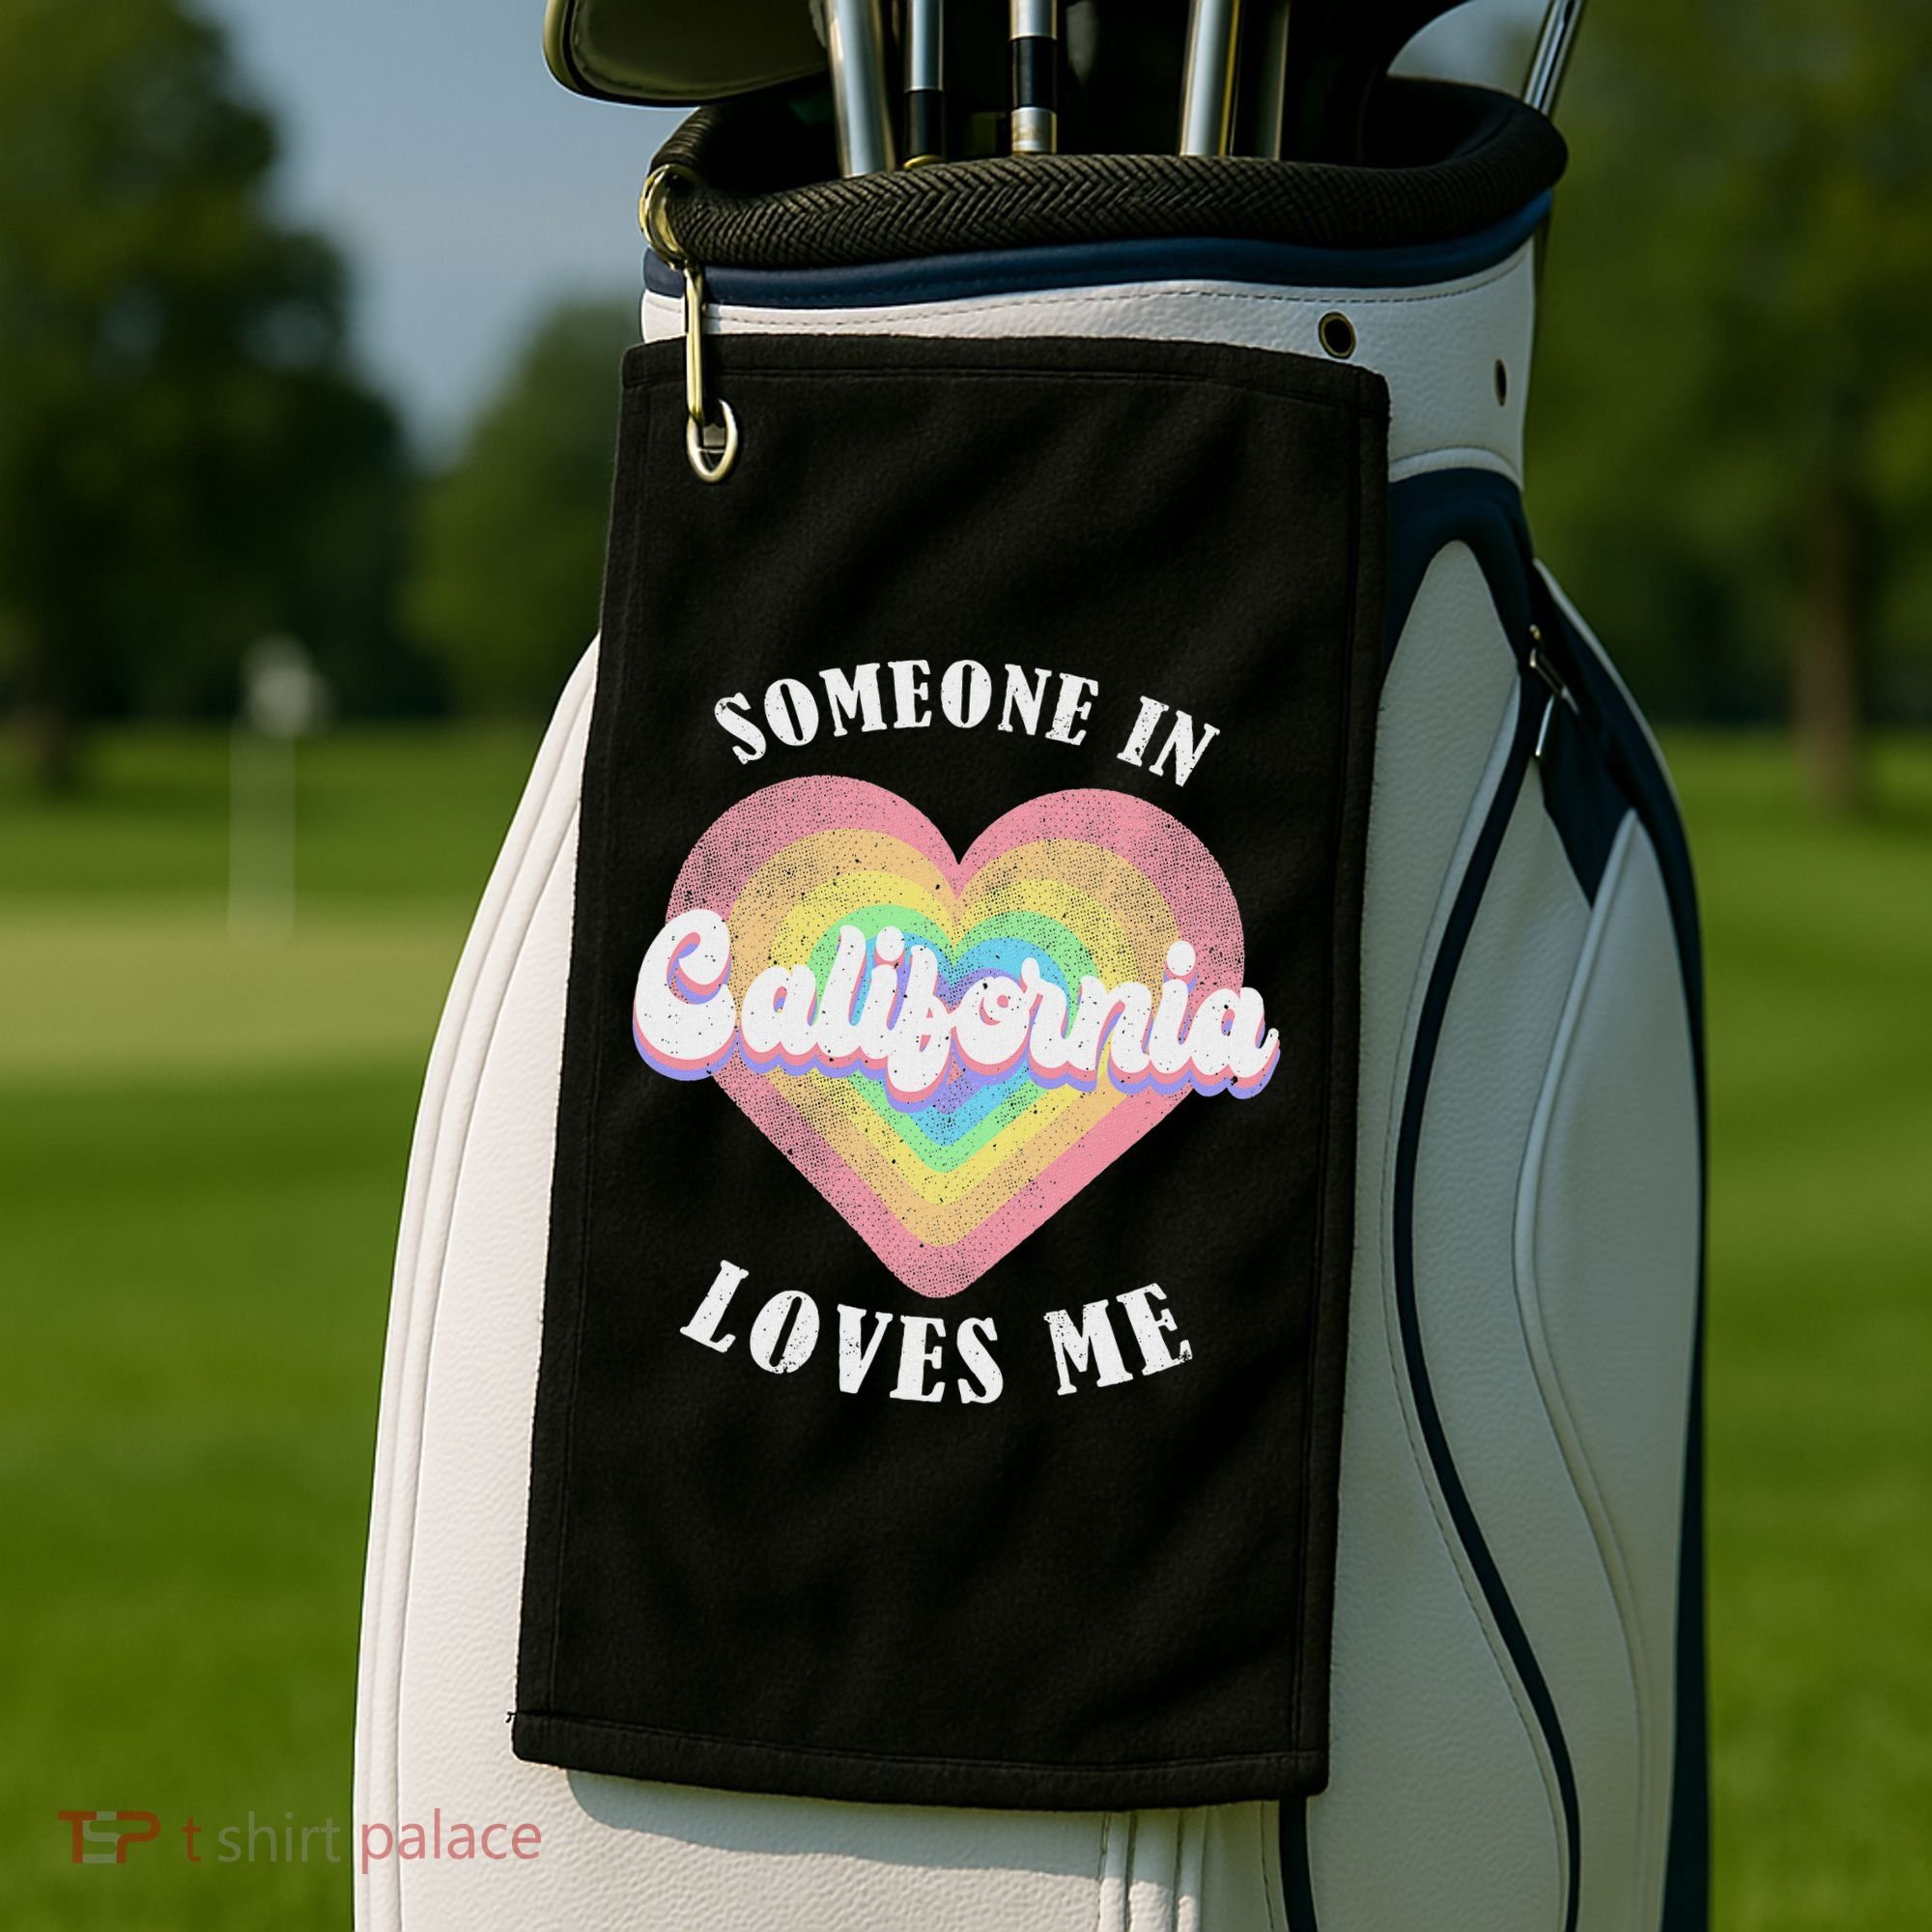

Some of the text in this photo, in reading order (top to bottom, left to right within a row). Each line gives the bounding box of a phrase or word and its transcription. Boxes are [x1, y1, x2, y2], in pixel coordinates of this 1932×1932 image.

[714, 659, 1221, 787] SOMEONE IN
[633, 908, 1281, 1109] California
[679, 1259, 1194, 1405] LOVES ME
